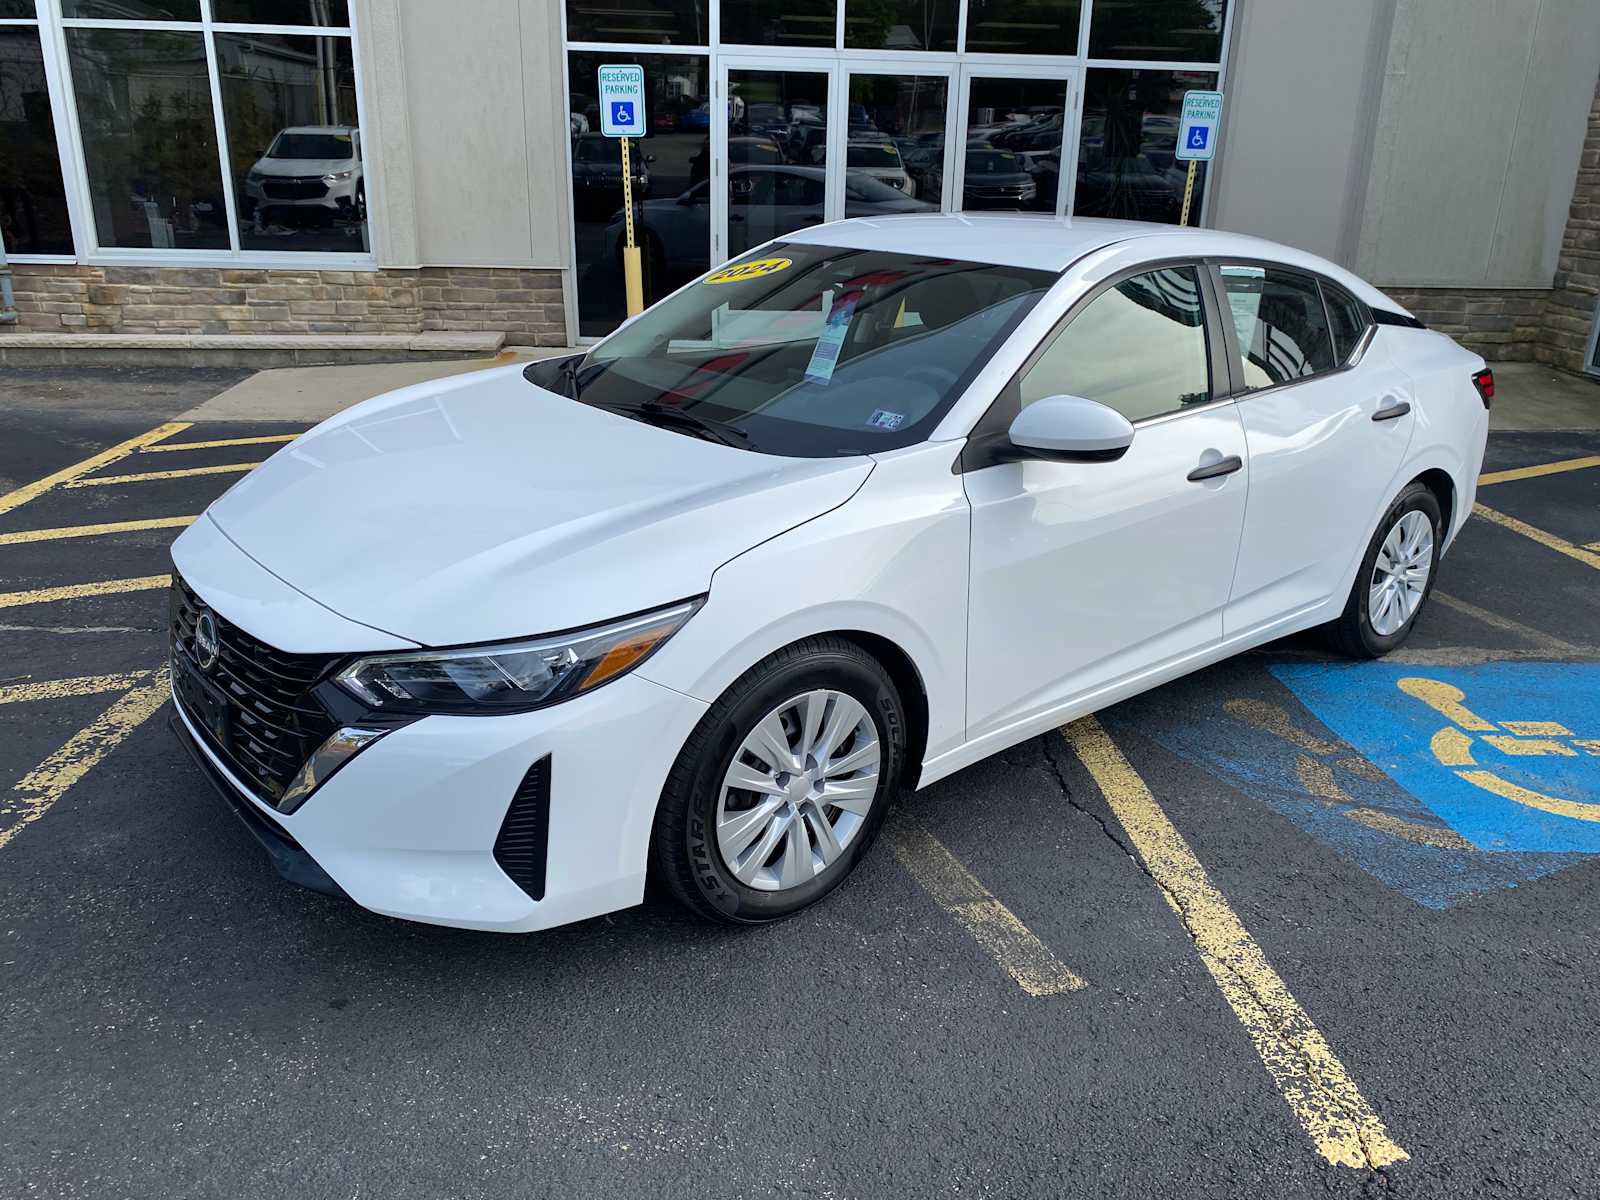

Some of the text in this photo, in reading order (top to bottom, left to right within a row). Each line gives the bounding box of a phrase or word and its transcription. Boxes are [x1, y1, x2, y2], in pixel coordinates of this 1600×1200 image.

[602, 72, 640, 82] RESERVED
[605, 84, 639, 94] PARKING
[1186, 97, 1220, 109] RESERVED
[1186, 110, 1216, 120] PARKING
[708, 260, 786, 282] 2024
